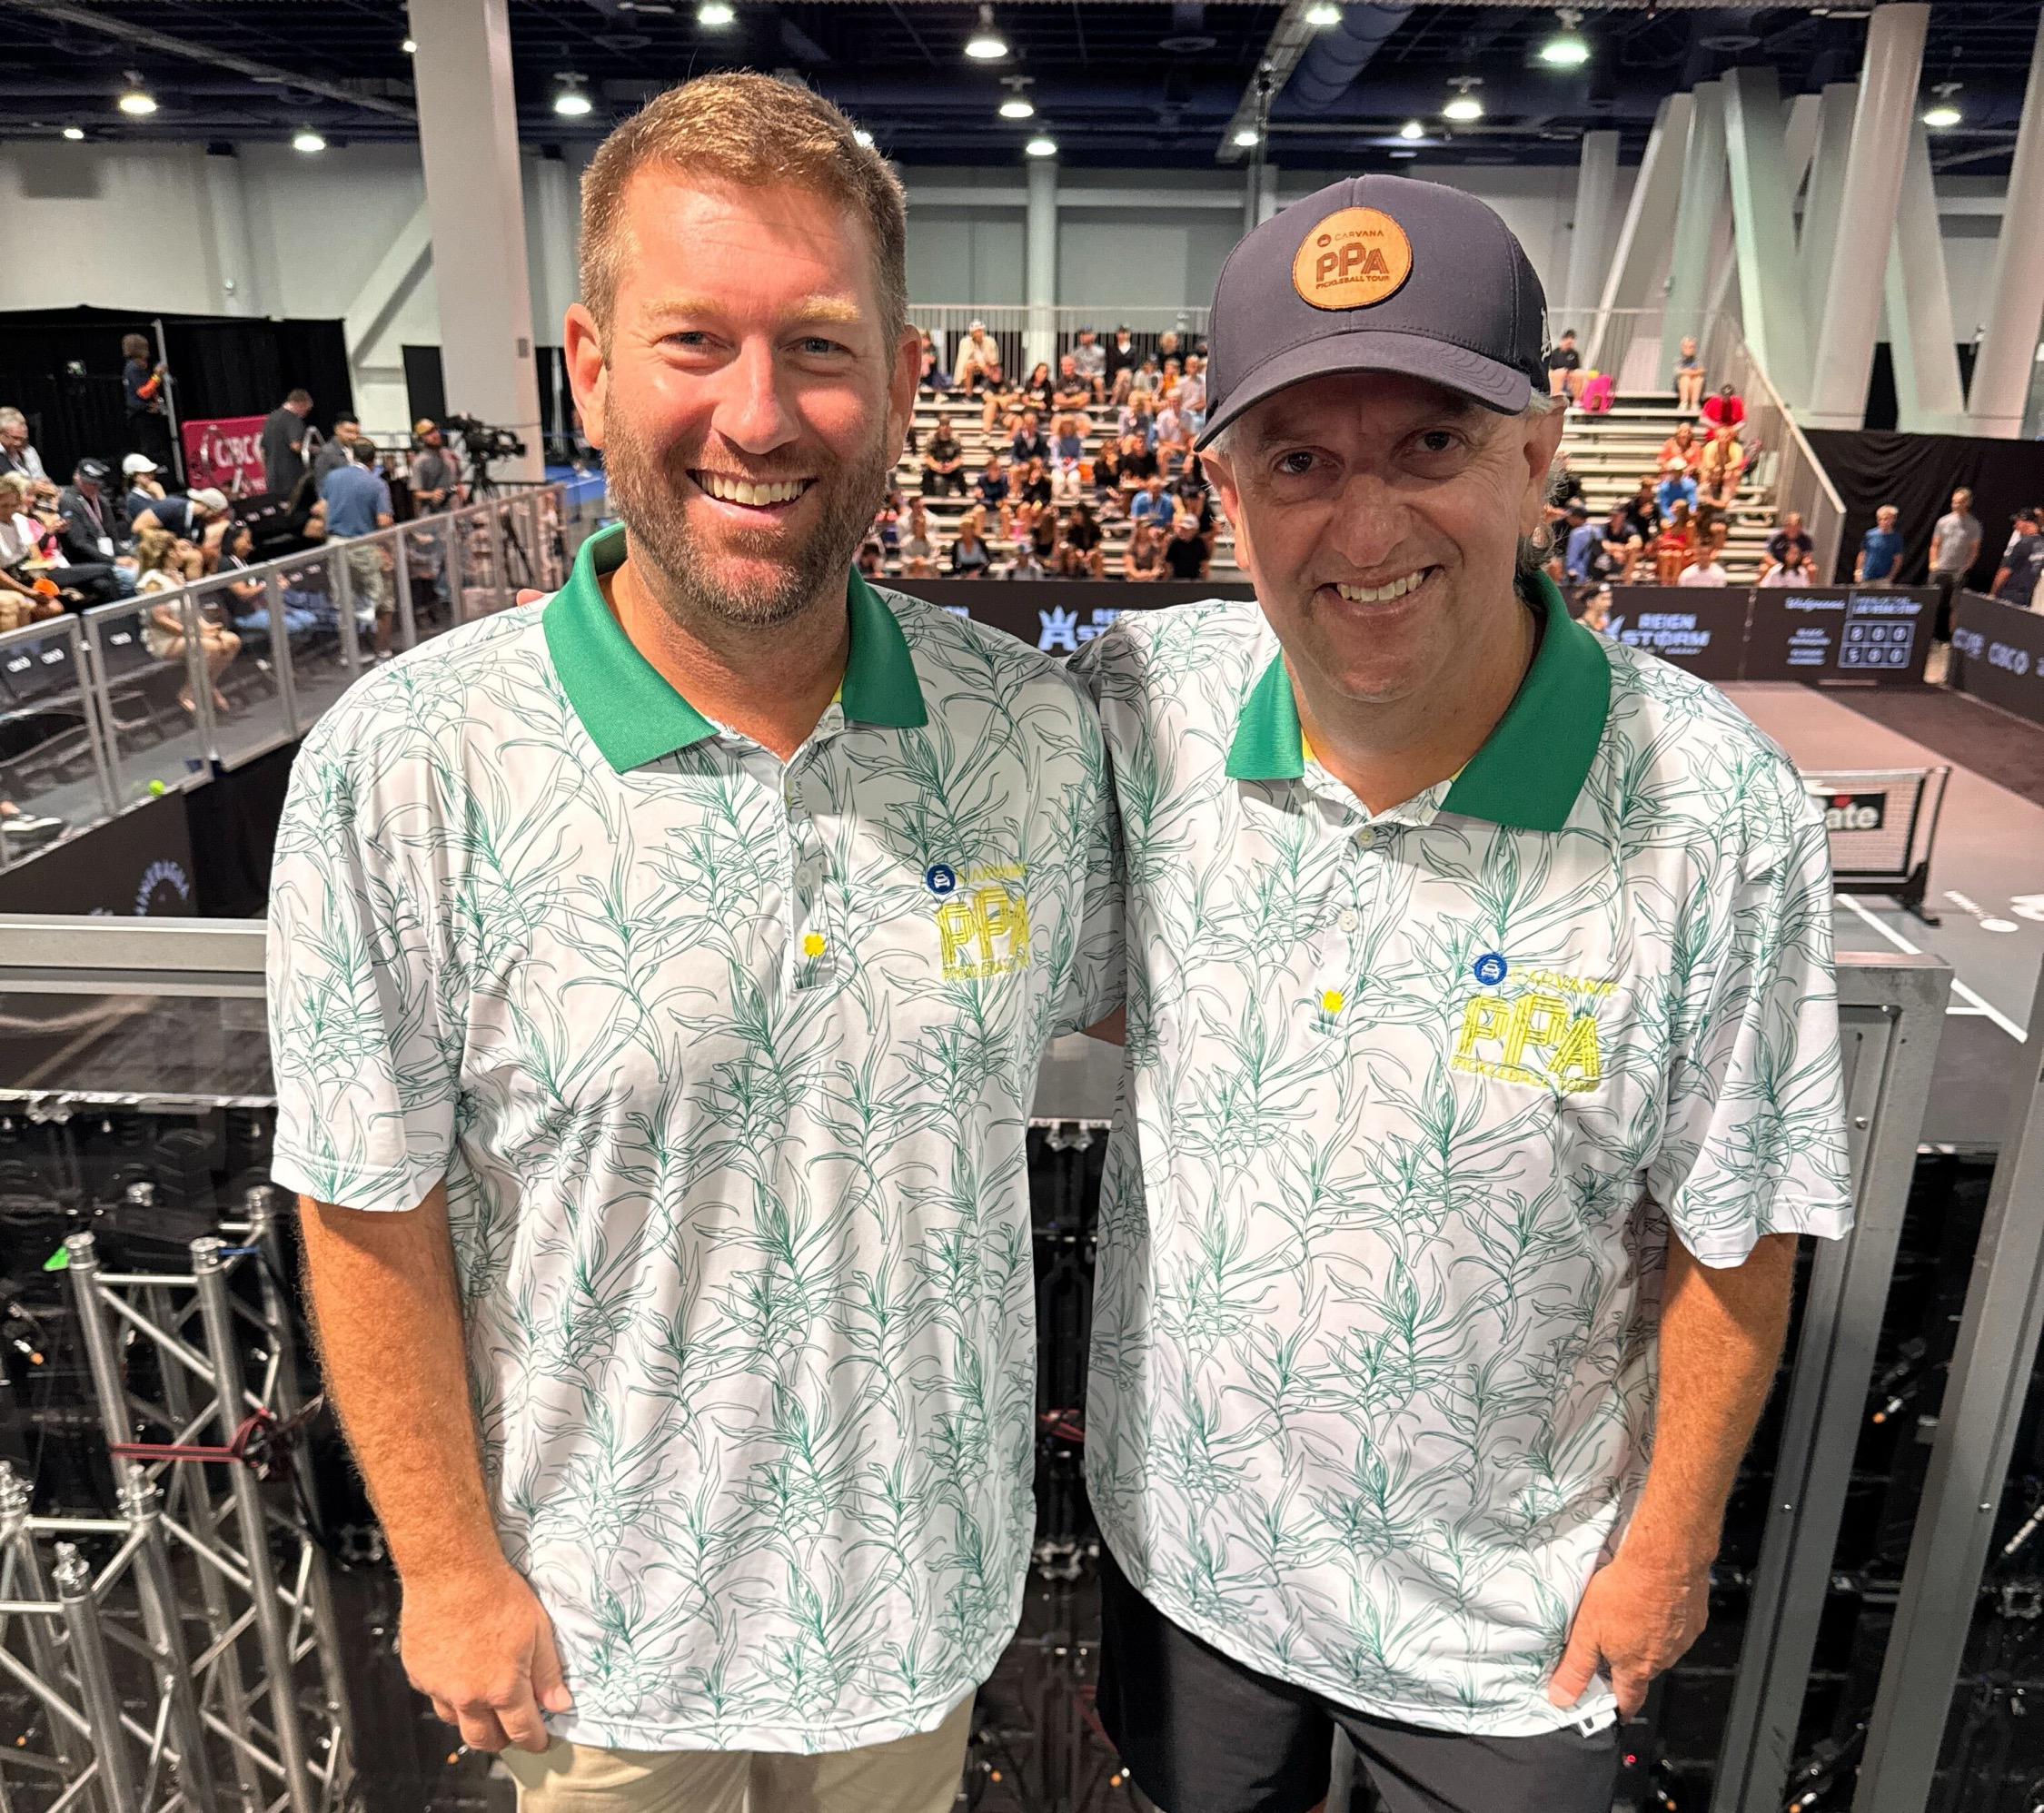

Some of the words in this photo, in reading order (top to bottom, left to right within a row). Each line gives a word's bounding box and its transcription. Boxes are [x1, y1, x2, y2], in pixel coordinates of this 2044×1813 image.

[1335, 230, 1384, 242] CARVANA
[1316, 242, 1390, 282] PPA
[1316, 276, 1364, 290] PICKLEBALL
[1365, 275, 1390, 283] TOUR
[1458, 994, 1600, 1077] PPA
[1452, 1055, 1550, 1088] PICKLEBALL
